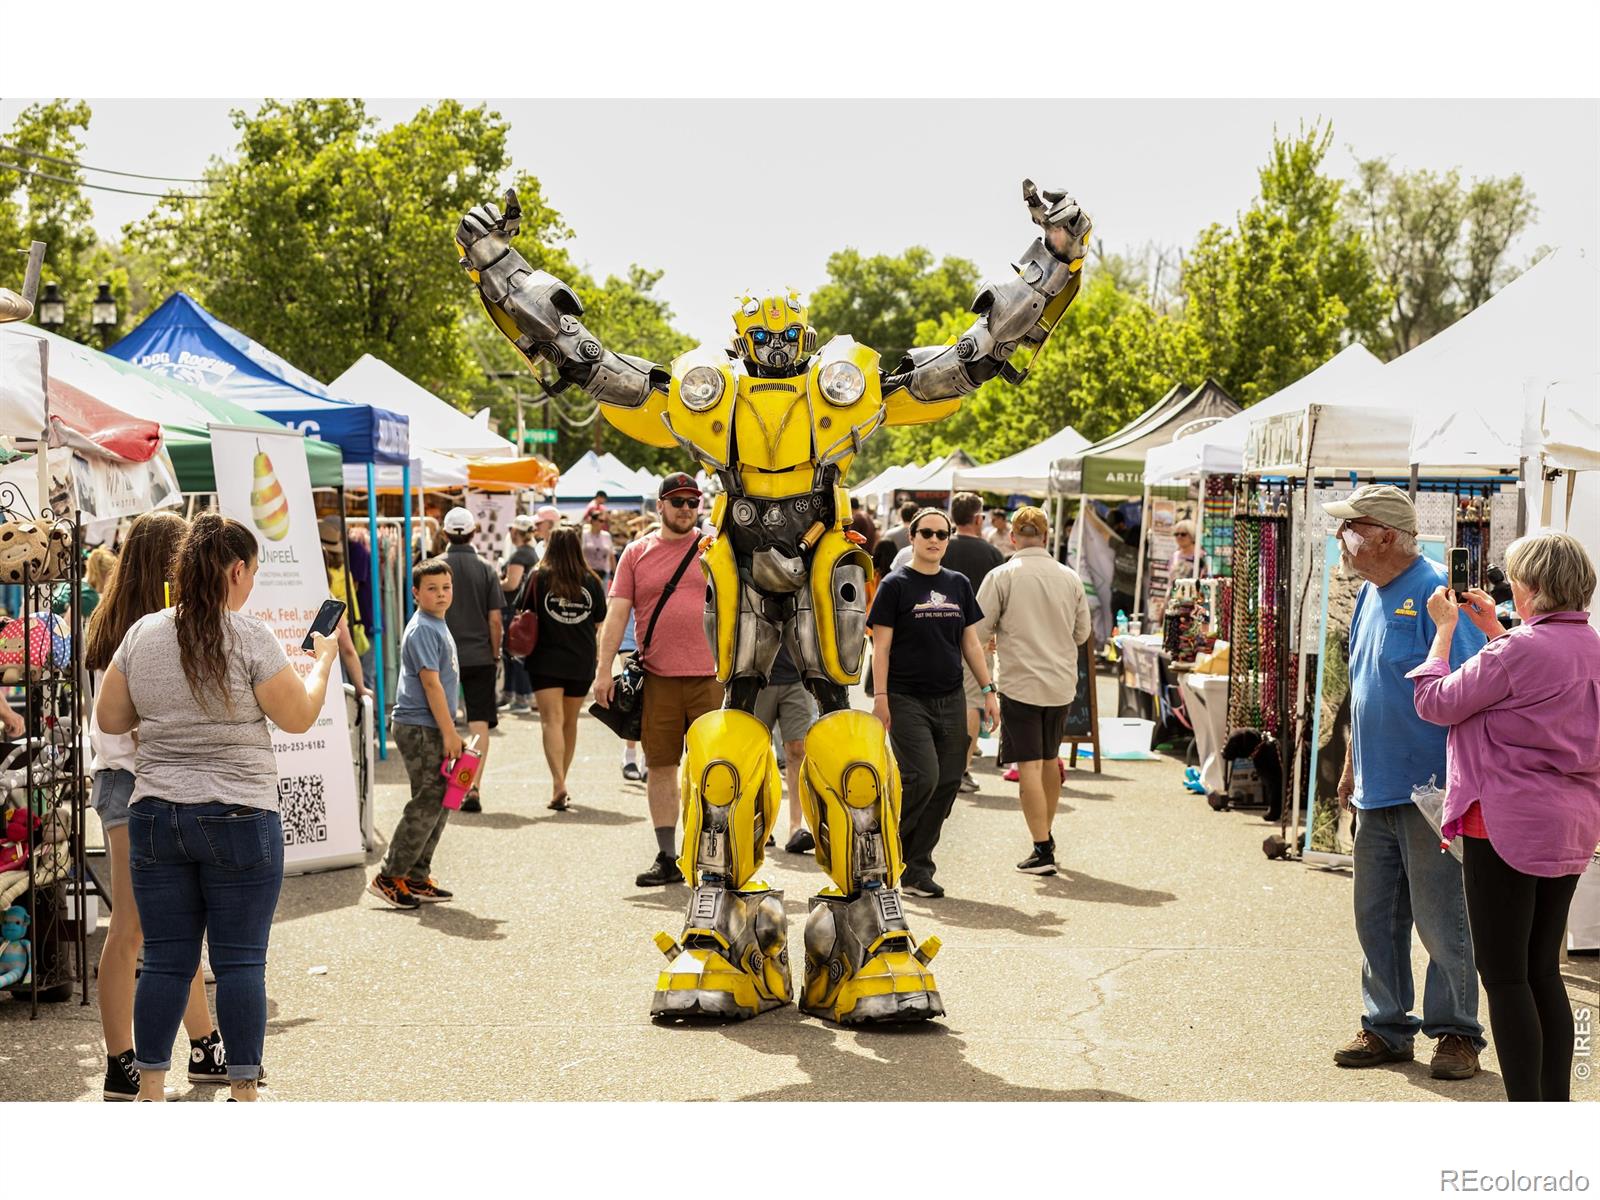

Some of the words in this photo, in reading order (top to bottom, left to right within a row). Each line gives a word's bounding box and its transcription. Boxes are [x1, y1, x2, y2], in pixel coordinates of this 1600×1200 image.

[279, 607, 302, 622] Feel,
[274, 626, 307, 639] nction
[273, 740, 326, 753] 720-253-6182
